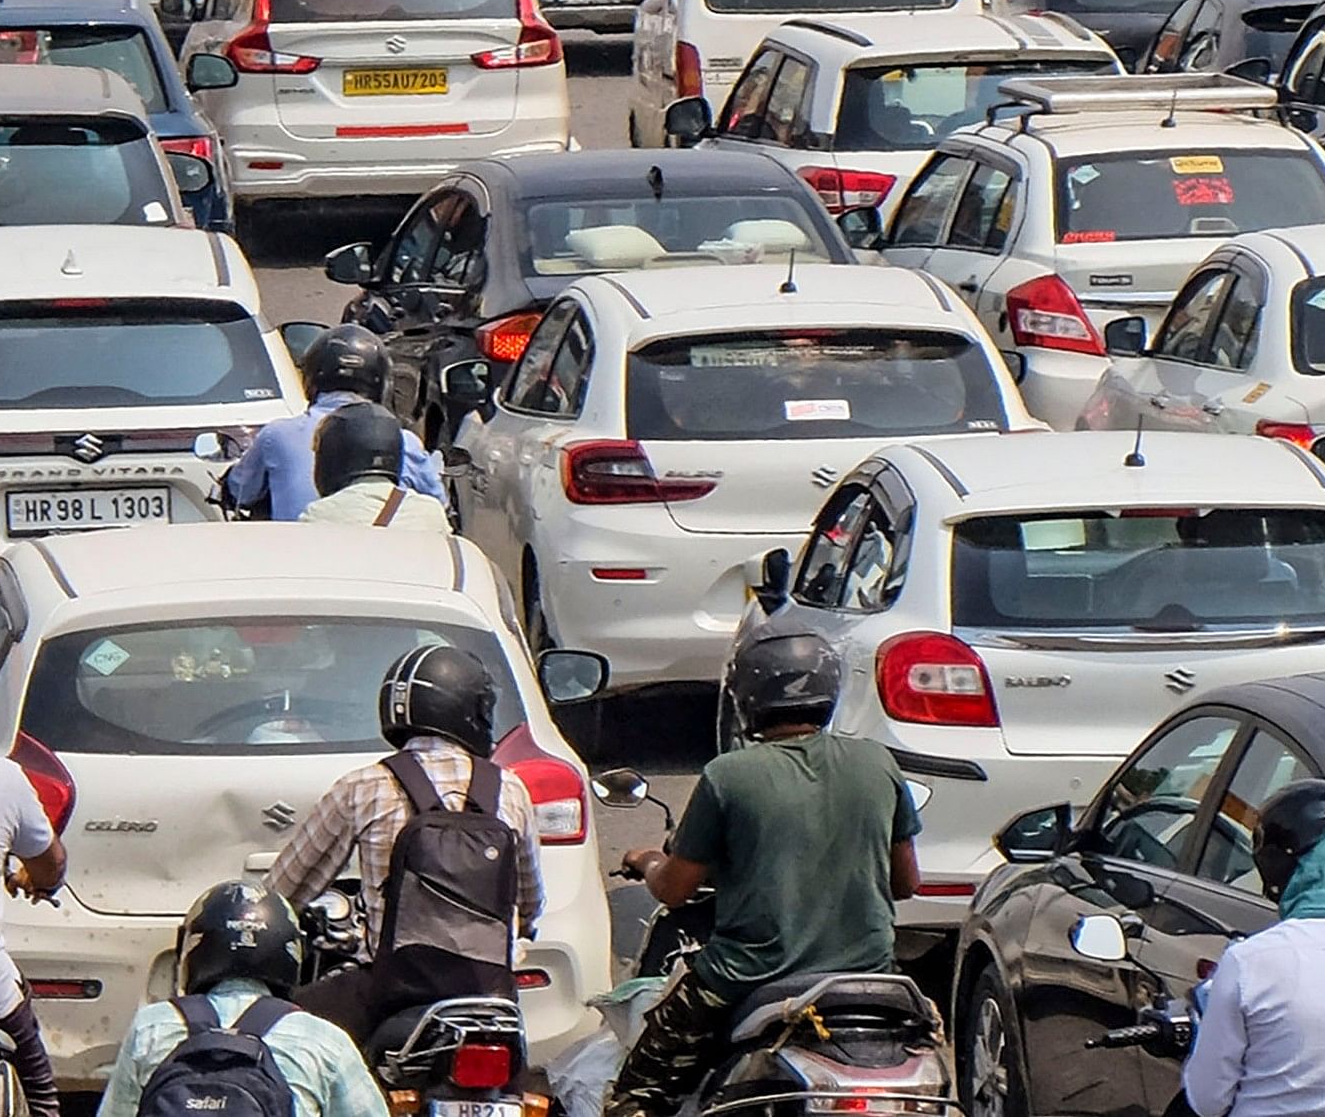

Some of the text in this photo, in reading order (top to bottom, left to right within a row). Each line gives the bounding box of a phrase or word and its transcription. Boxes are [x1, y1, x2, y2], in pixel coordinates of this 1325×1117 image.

[93, 466, 185, 476] VITARA
[25, 494, 164, 522] HR 98 L 1303
[84, 820, 159, 832] CELERIO
[185, 1095, 228, 1109] safari
